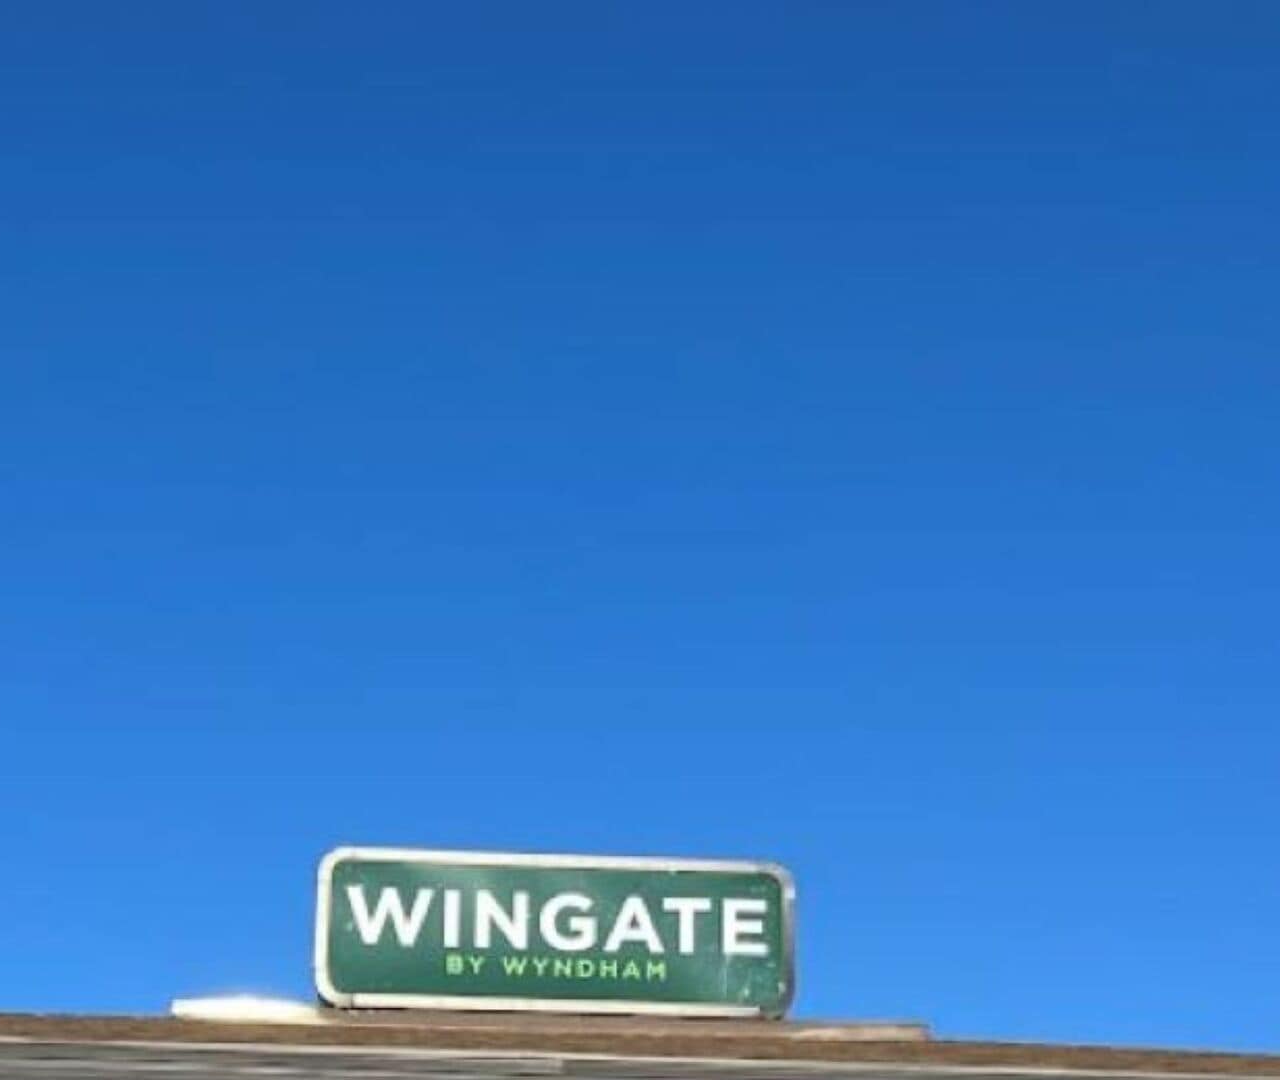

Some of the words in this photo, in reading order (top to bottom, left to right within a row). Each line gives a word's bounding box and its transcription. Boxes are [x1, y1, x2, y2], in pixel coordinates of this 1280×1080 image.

[345, 885, 769, 956] WINGATE
[446, 955, 484, 976] BY
[503, 956, 668, 980] WYNDHAM
